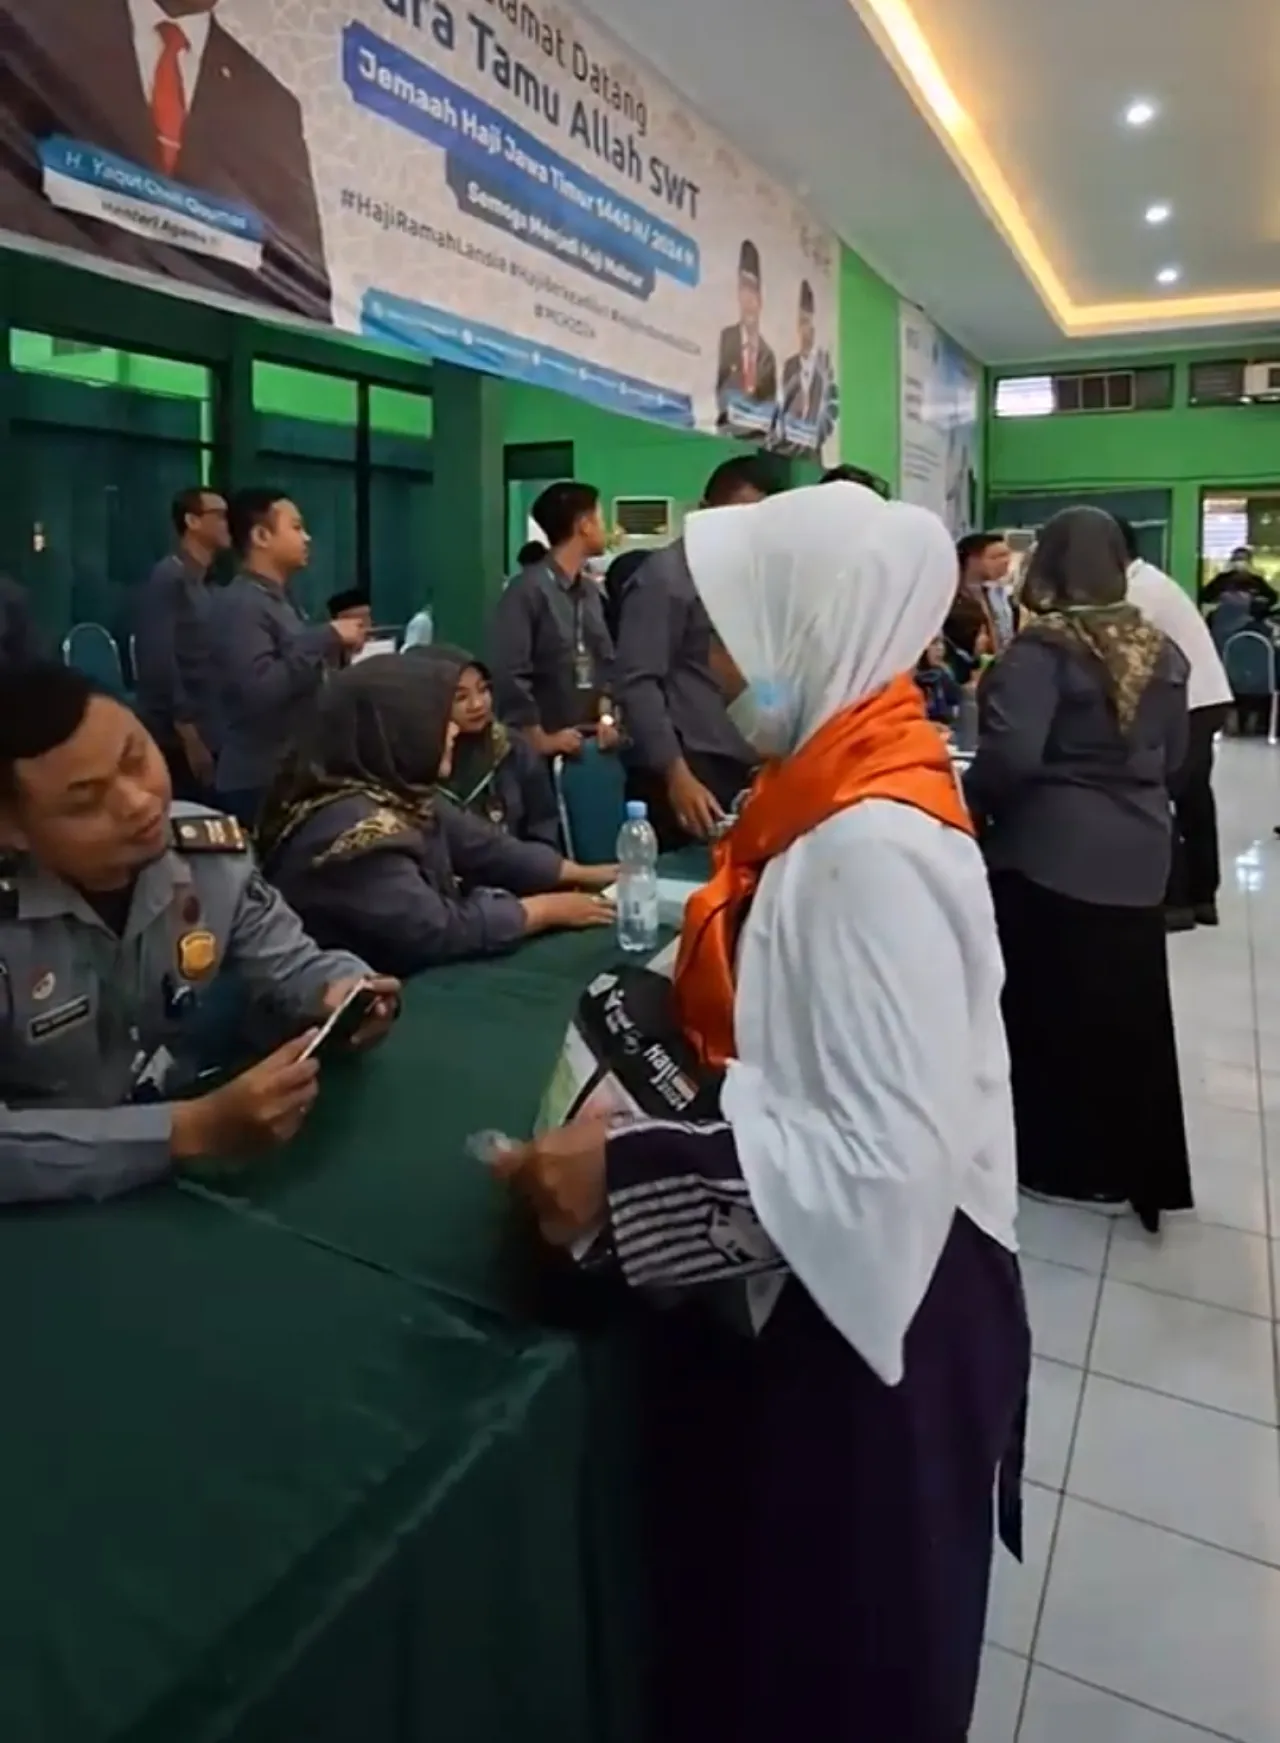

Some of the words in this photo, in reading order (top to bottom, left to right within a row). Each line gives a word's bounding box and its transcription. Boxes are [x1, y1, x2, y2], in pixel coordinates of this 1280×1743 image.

[358, 46, 458, 129] Jemaah
[460, 108, 503, 155] Haji
[503, 134, 549, 184] Jawa
[550, 164, 594, 212] Timur
[467, 12, 560, 126] Tamu
[569, 99, 642, 183] Allah
[649, 155, 701, 220] SWT
[572, 41, 648, 137] Datang
[338, 188, 508, 274] #HajiRamahLansia
